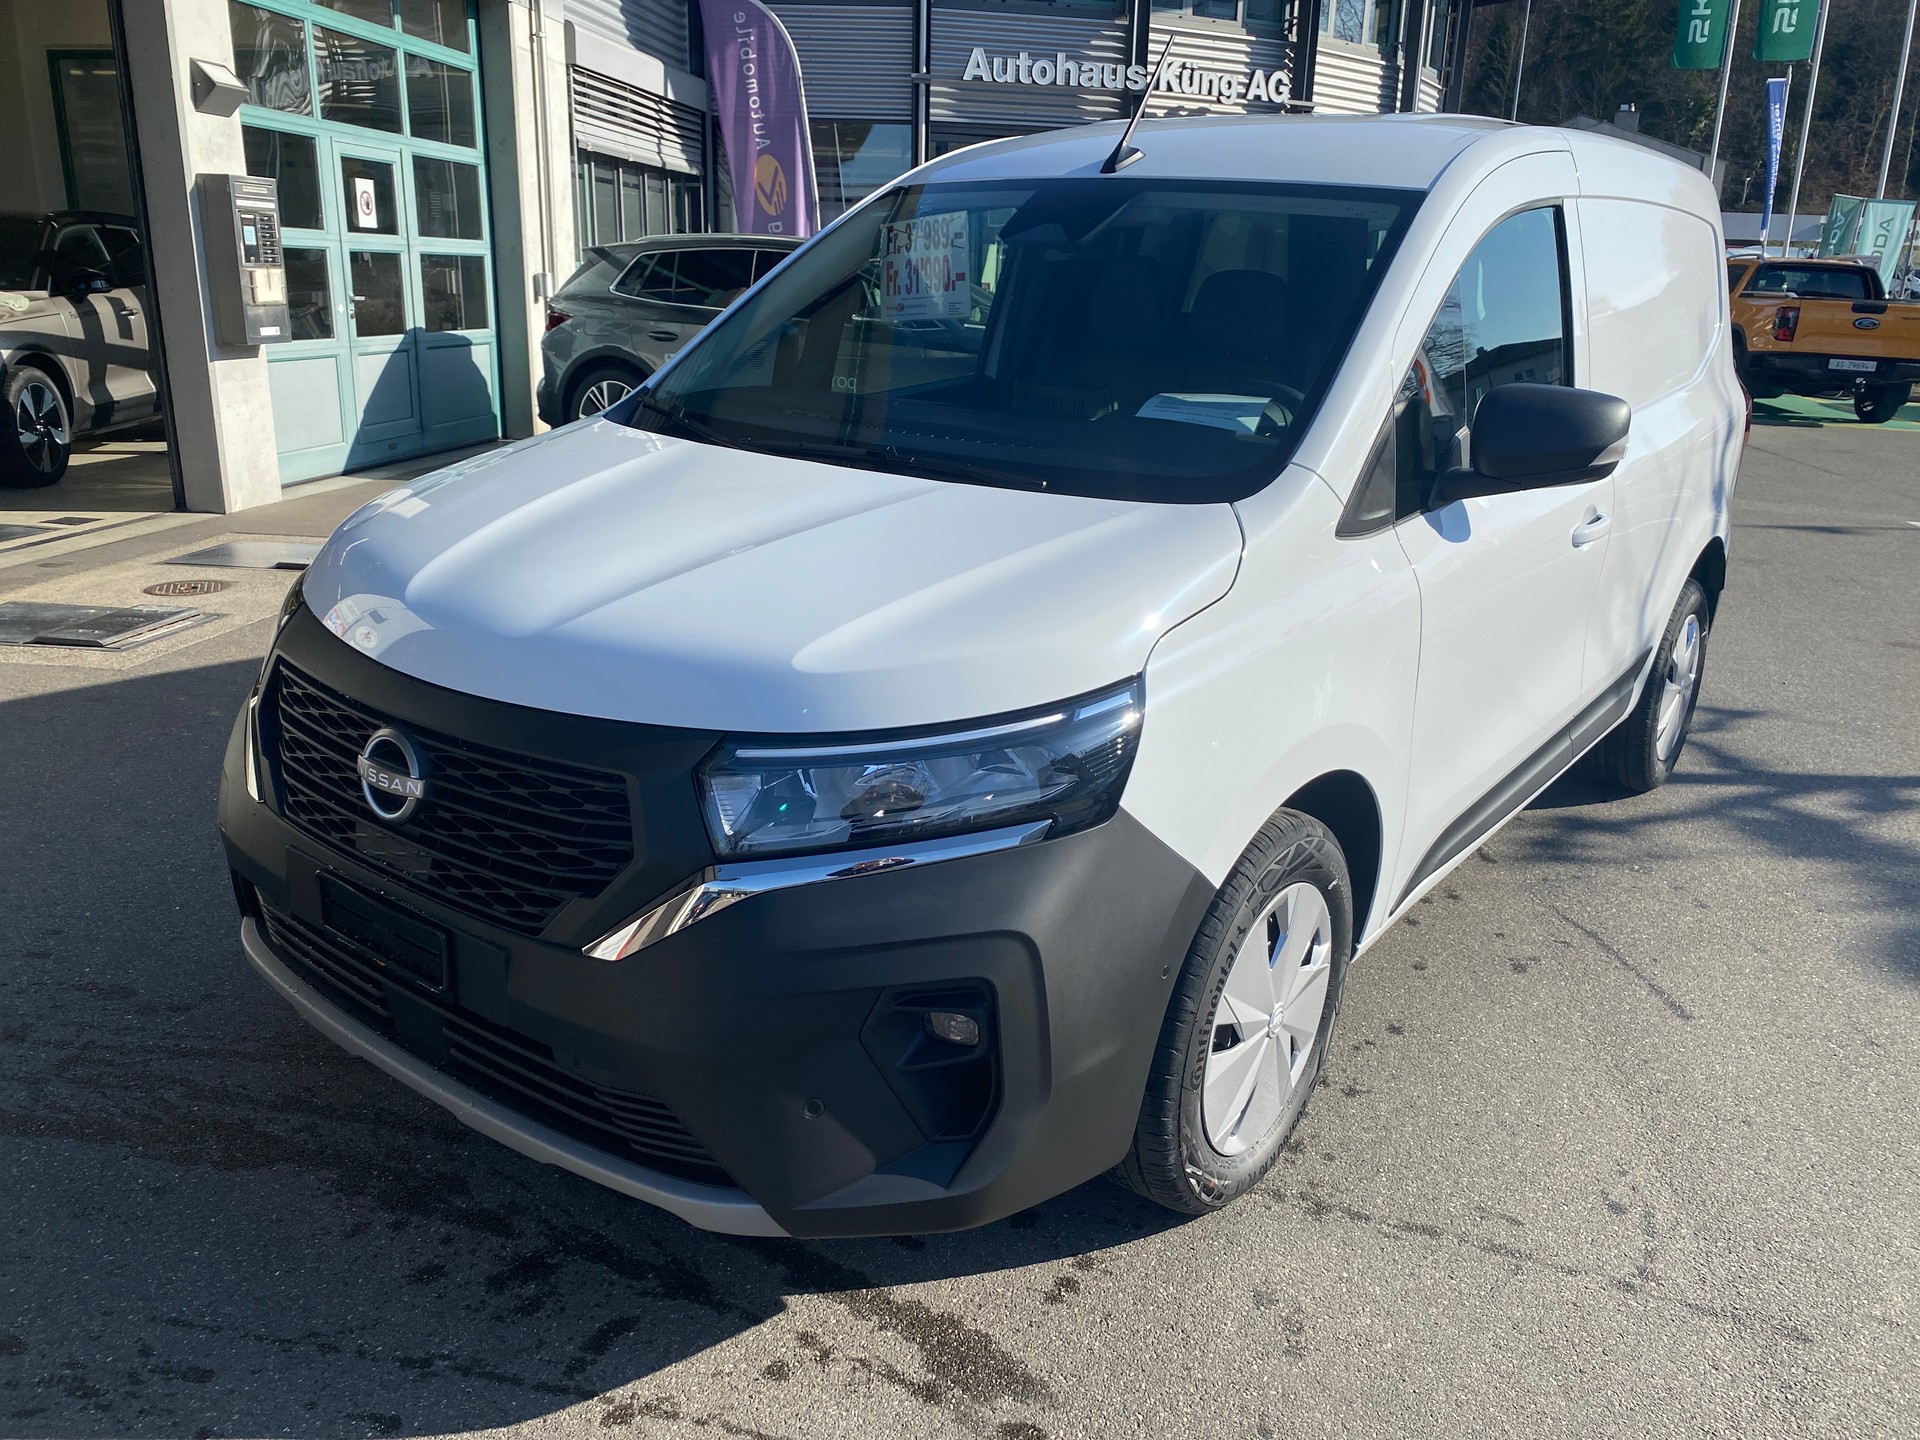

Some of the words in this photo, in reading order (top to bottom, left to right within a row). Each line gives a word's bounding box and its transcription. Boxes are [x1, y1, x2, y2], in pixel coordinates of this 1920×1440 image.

[963, 47, 1147, 91] Autohaus
[1159, 61, 1239, 105] Küng
[1246, 69, 1291, 104] AG
[886, 261, 901, 296] Fr.
[358, 760, 421, 796] NISSAN
[1190, 940, 1239, 1091] Continental
